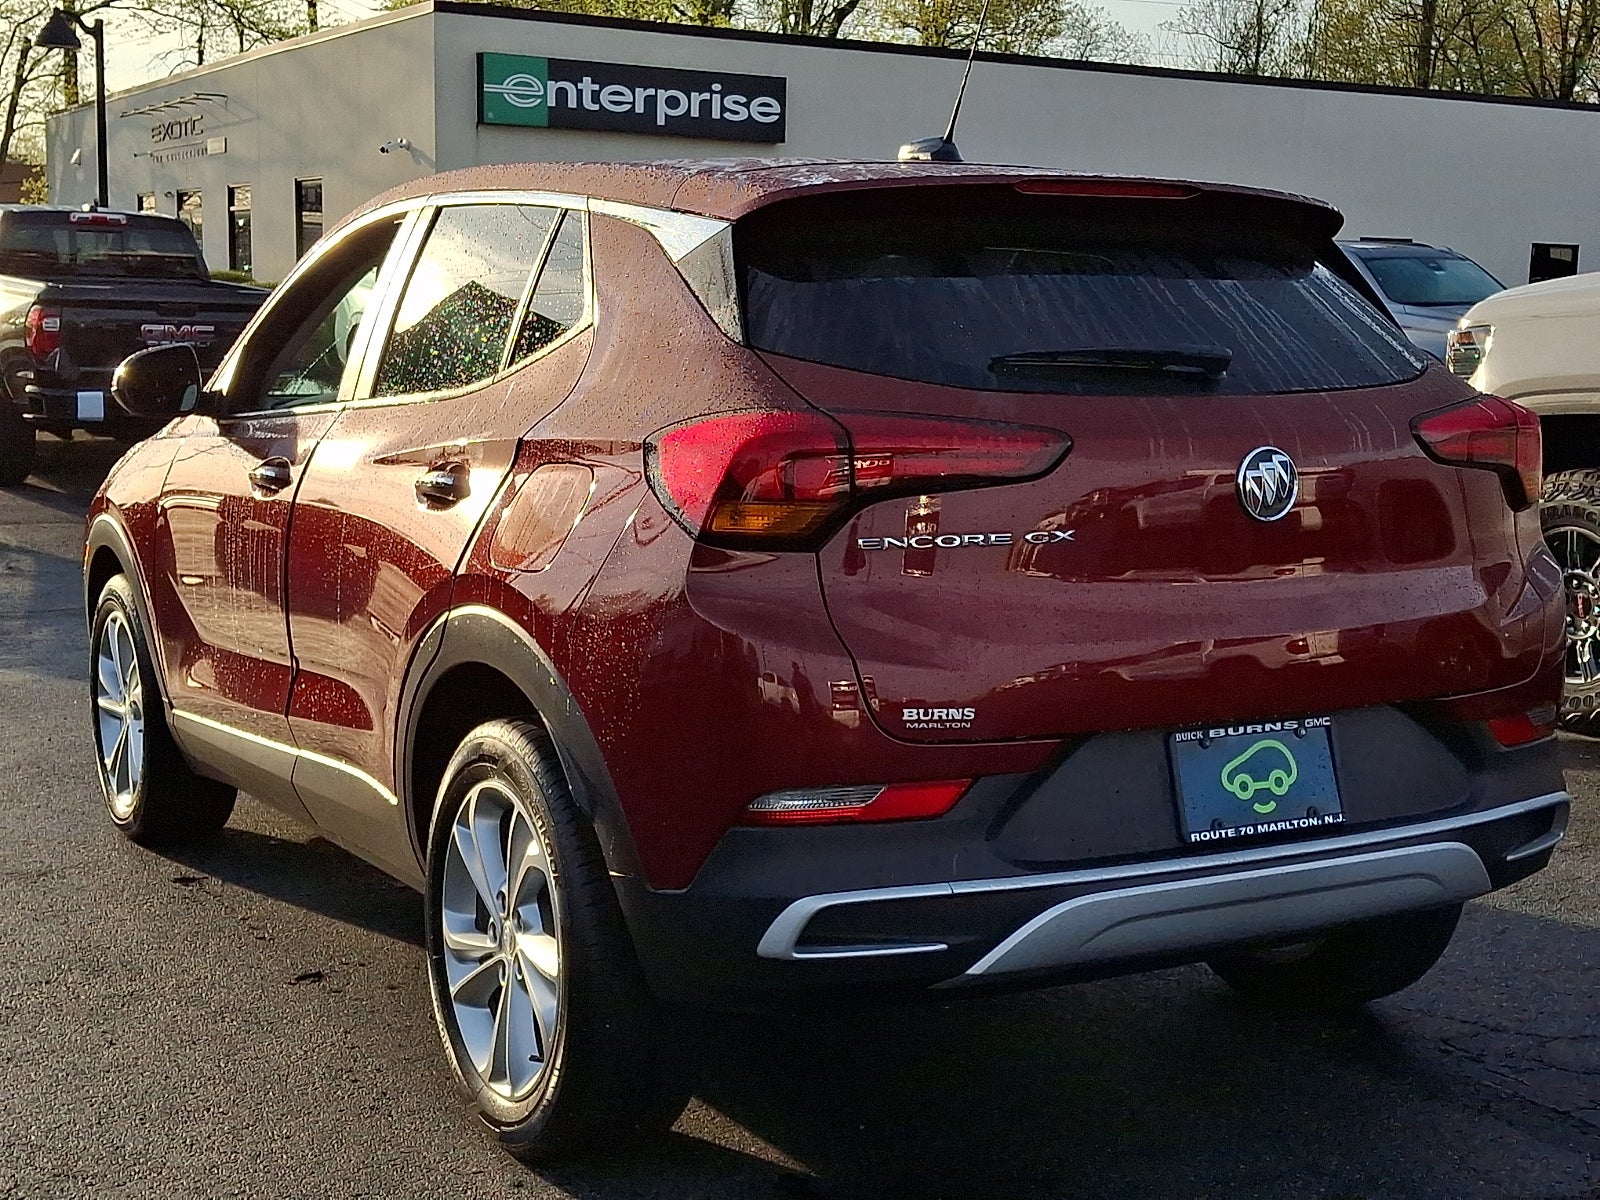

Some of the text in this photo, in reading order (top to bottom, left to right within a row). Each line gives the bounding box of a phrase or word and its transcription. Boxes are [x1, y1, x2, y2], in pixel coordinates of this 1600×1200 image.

[484, 73, 781, 126] enterprise
[151, 114, 204, 144] EXOTIC
[140, 324, 215, 341] GMC
[857, 529, 1076, 550] ENCORE GX
[902, 707, 976, 721] BURNS
[1175, 716, 1332, 742] BUICK BURNS GMC
[1190, 813, 1347, 843] ROUTE 70 MARLTON, N.J.
